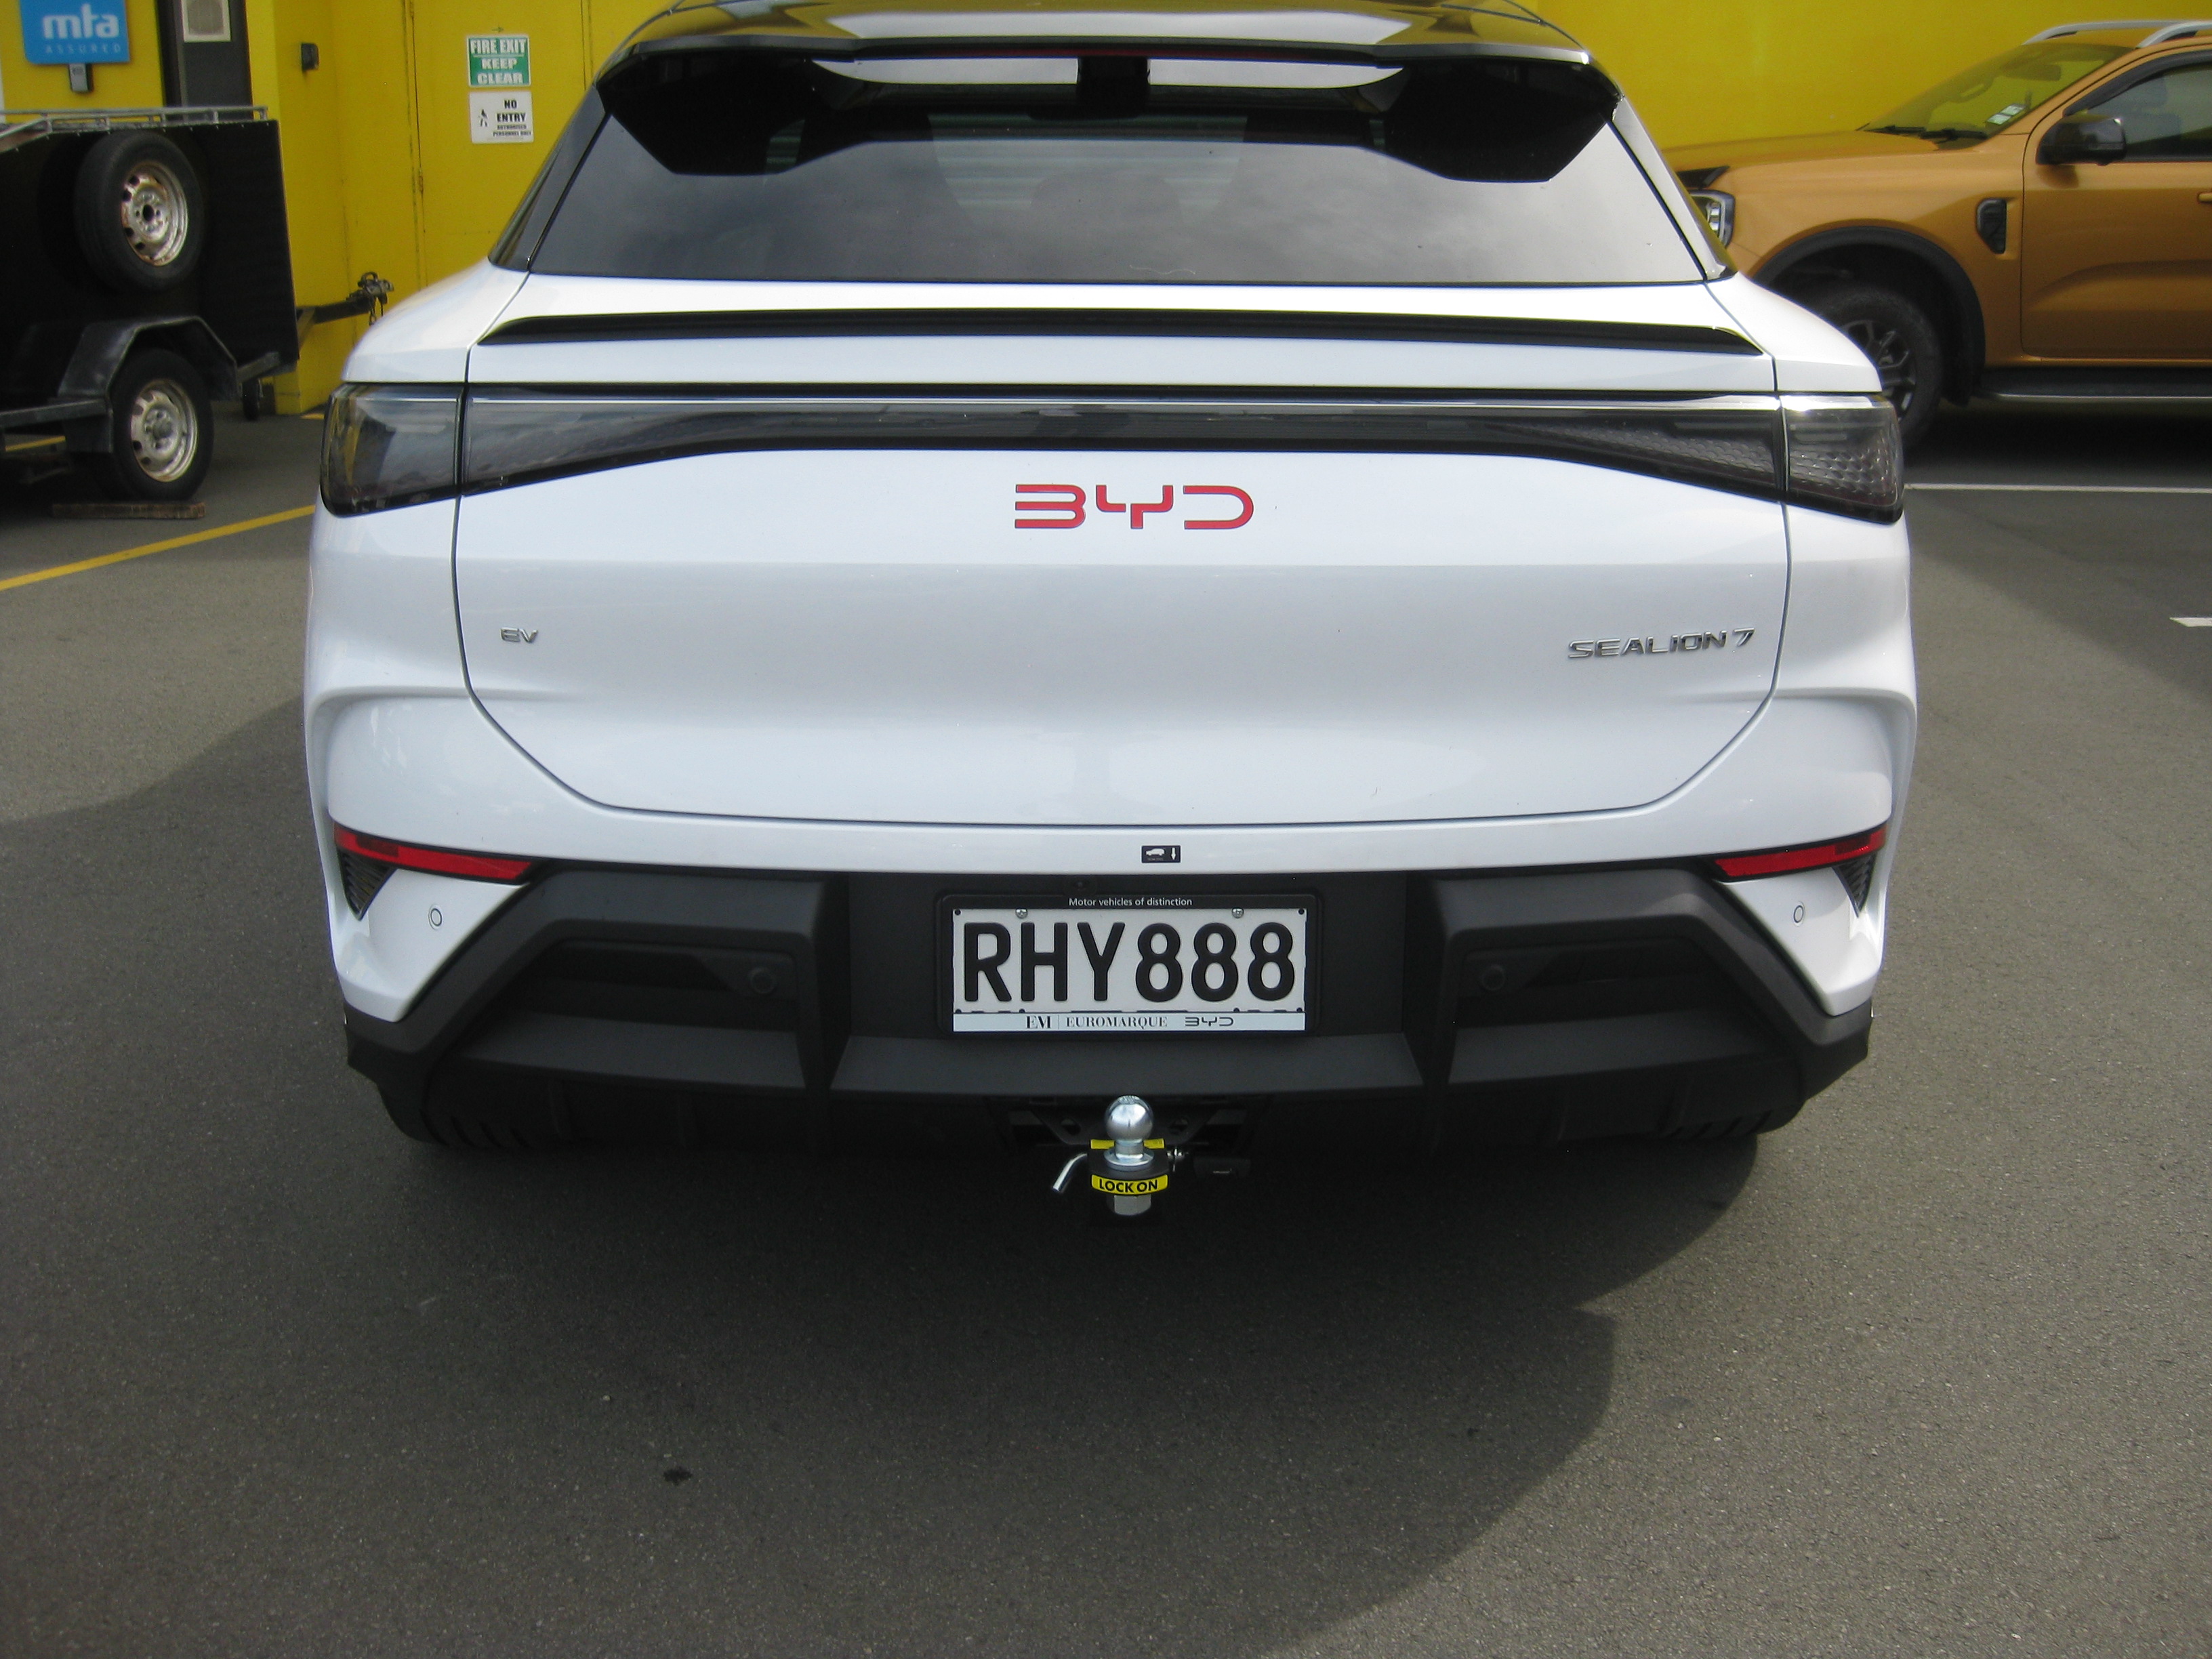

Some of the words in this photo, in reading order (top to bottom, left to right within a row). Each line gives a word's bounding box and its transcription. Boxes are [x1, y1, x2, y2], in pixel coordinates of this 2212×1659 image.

[43, 3, 120, 39] mta
[45, 43, 121, 54] ASSURED
[470, 39, 497, 54] FIRE
[499, 39, 527, 54] EXIT
[481, 58, 518, 70] KEEP
[477, 73, 523, 85] CLEAR
[504, 100, 517, 109] NO
[497, 113, 526, 122] ENTRY
[1015, 484, 1254, 530] BYD
[499, 627, 538, 643] EV
[1568, 629, 1727, 659] SEALION
[1732, 627, 1756, 647] 7
[1069, 897, 1097, 907] Motor
[1098, 897, 1132, 907] vehicles
[1134, 897, 1144, 906] of
[1147, 897, 1193, 906] distinction
[963, 922, 1296, 1002] RHY888
[1065, 1016, 1168, 1029] EUROMARQUE
[1185, 1017, 1234, 1027] BYD
[1099, 1179, 1134, 1193] LOCK
[1136, 1179, 1158, 1192] ON
